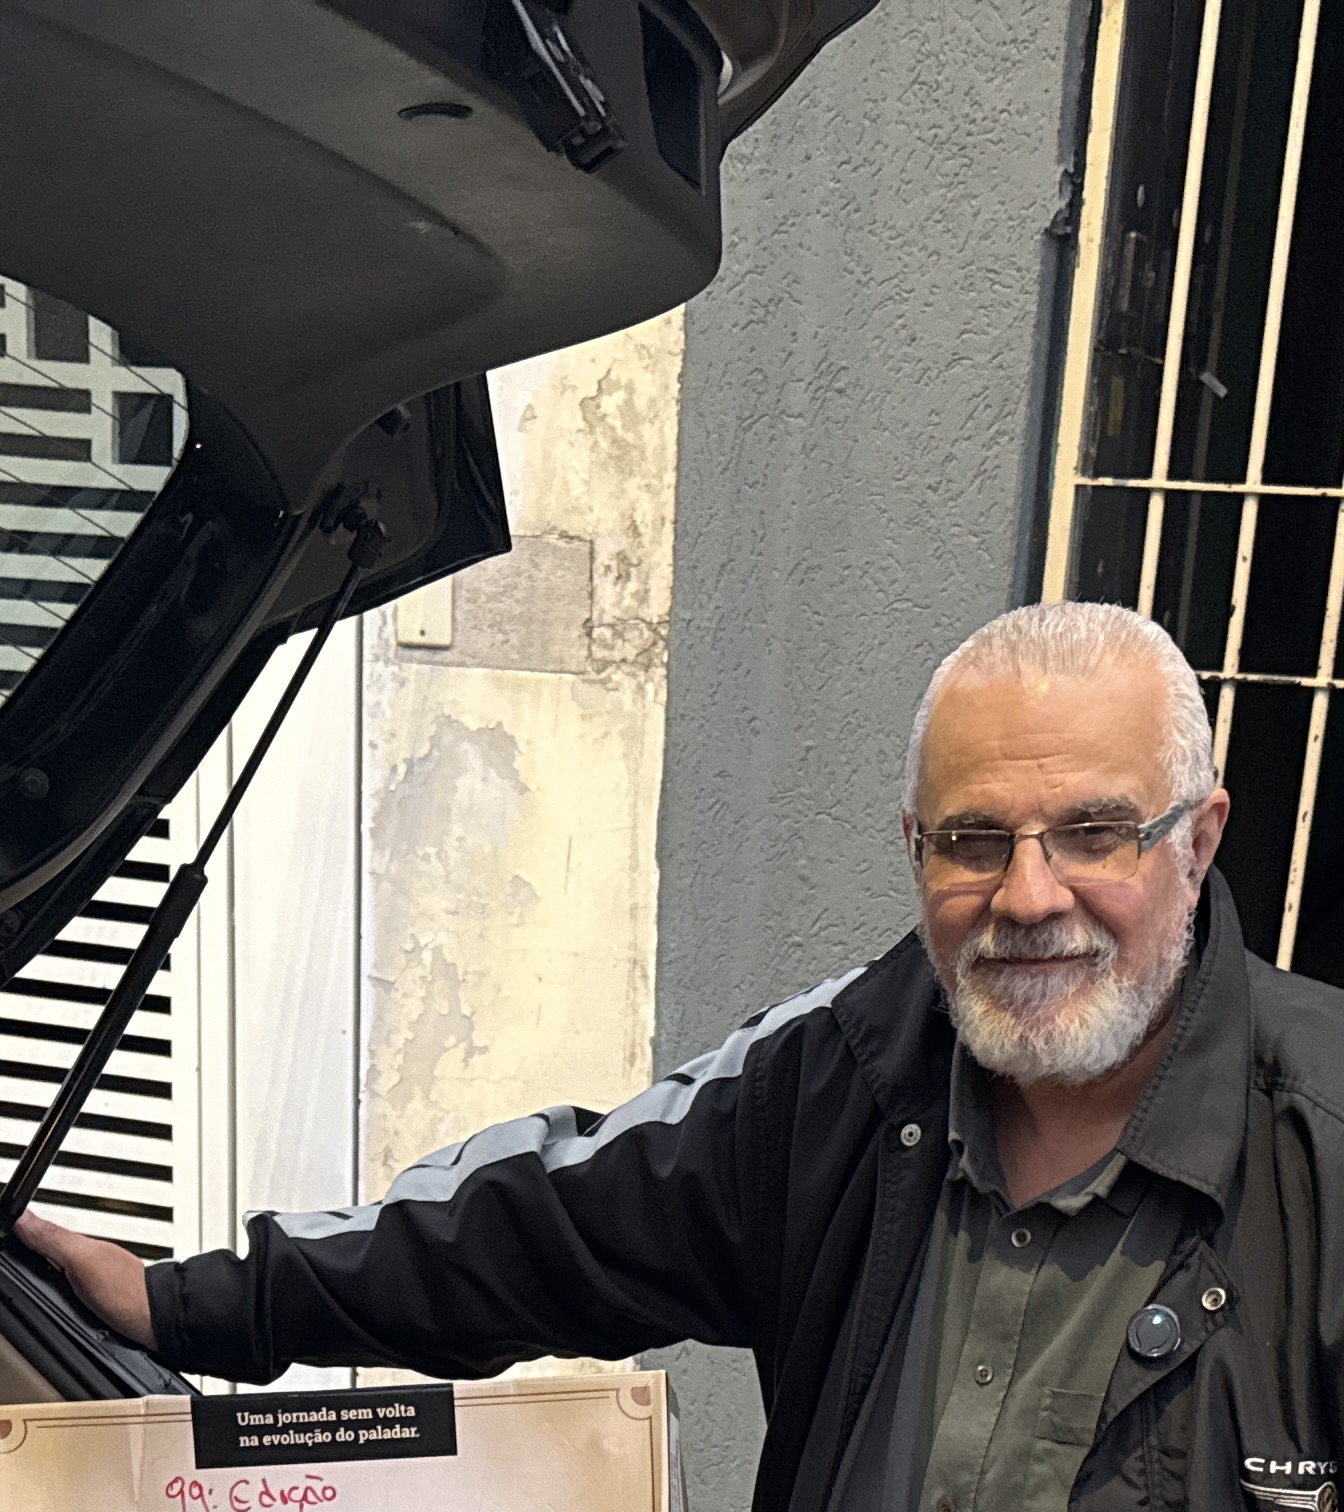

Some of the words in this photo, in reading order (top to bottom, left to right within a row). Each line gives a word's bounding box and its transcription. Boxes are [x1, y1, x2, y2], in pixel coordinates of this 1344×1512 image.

[236, 1411, 274, 1427] Uma
[277, 1407, 337, 1428] jornada
[340, 1406, 374, 1421] sem
[376, 1403, 416, 1419] volta
[239, 1434, 259, 1447] na
[262, 1429, 332, 1447] evolução
[335, 1427, 355, 1443] do
[358, 1424, 421, 1444] paladar.
